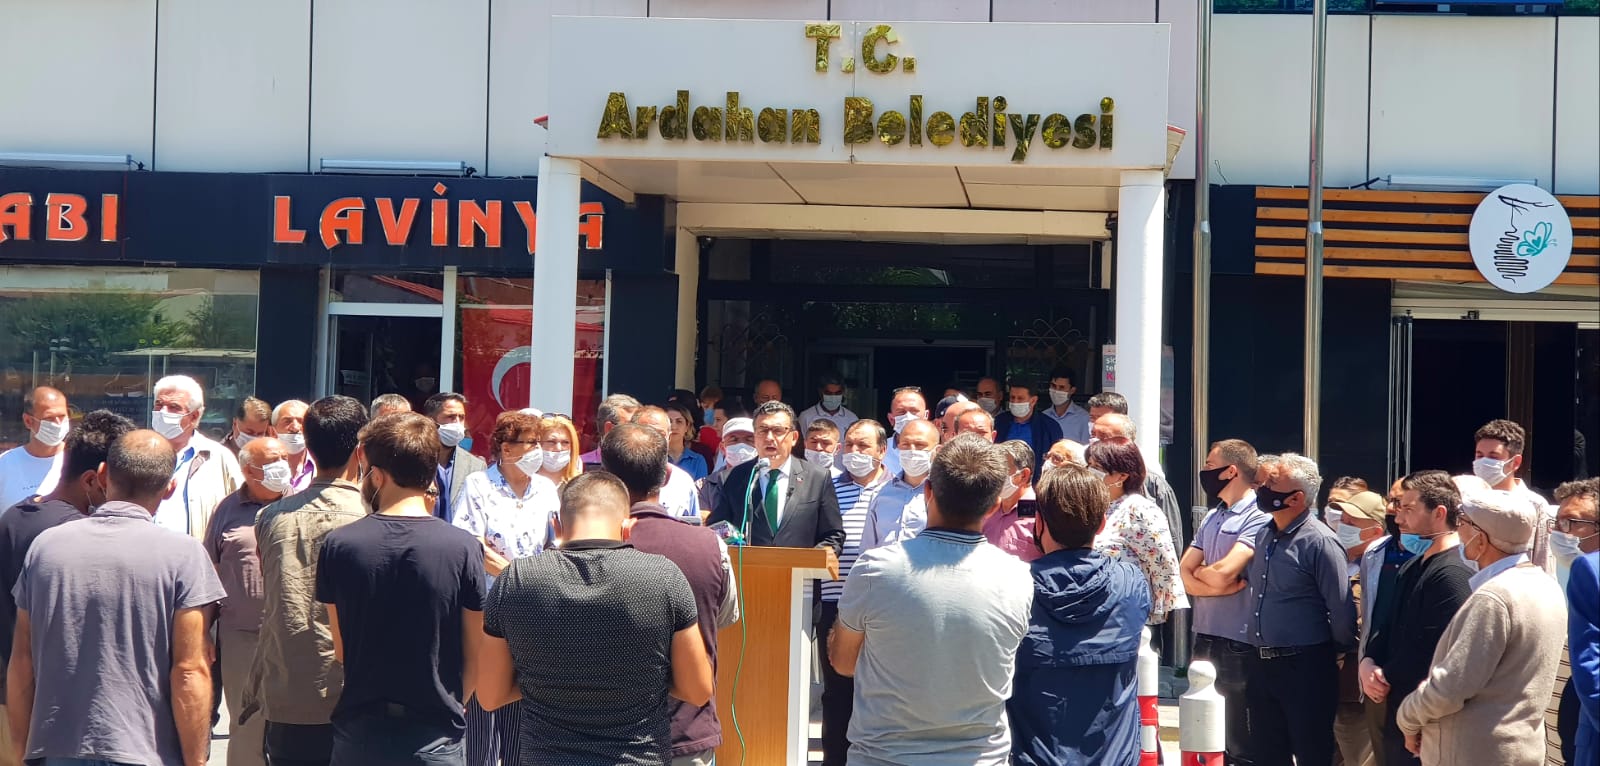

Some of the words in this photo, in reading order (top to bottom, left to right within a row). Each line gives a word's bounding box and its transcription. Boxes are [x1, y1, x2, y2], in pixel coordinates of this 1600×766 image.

[805, 23, 917, 74] T.C.
[597, 90, 822, 144] Ardahan
[844, 94, 1114, 161] Belediyesi
